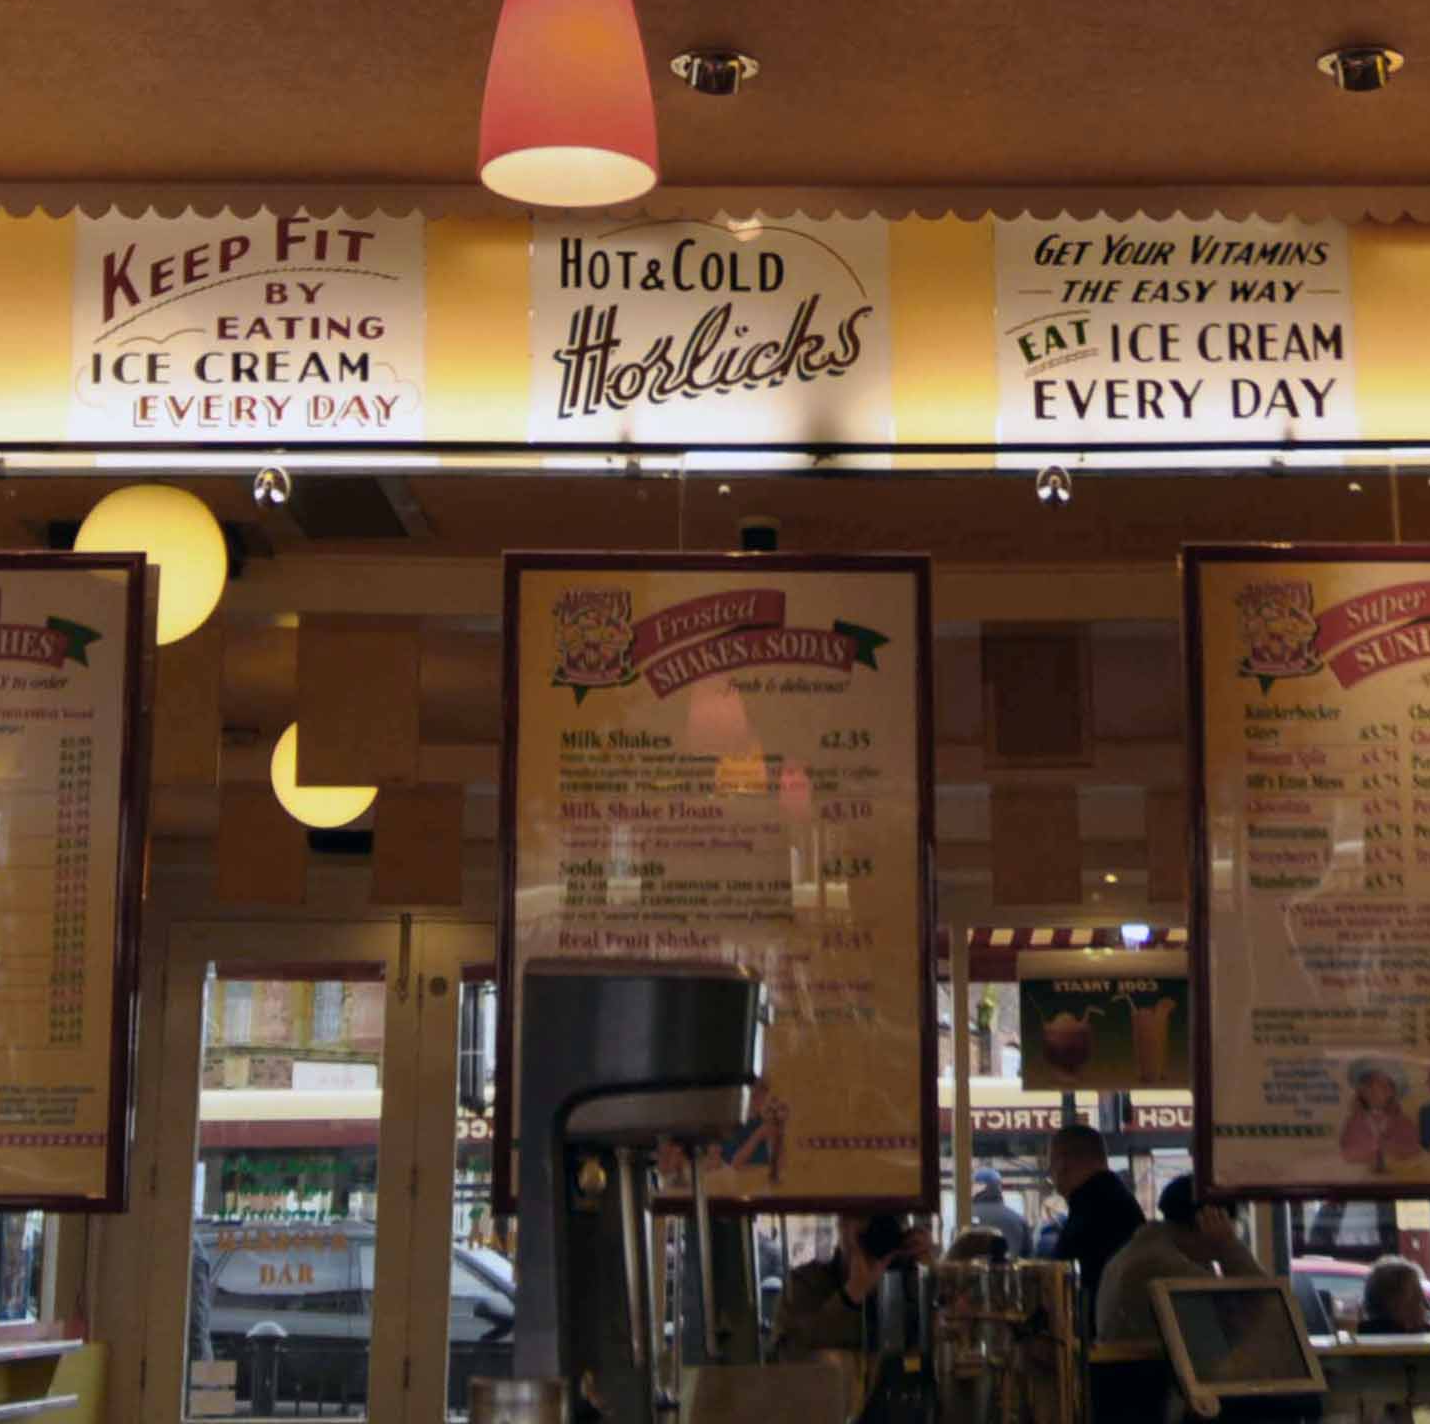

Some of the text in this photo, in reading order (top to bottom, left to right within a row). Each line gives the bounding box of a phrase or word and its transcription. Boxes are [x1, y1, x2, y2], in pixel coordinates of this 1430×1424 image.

[1034, 232, 1331, 269] GET YOUR VITAMINS
[101, 216, 377, 325] KEEP FIT
[265, 281, 326, 306] BY
[1059, 278, 1305, 306] THE EASY WAY
[214, 314, 386, 342] EATING
[1015, 314, 1347, 366] EAT ICE CREAM
[91, 350, 374, 385] ICE CREAM
[553, 292, 875, 421] Horlicks
[133, 393, 402, 429] EVERY DAY
[1032, 377, 1339, 423] EVERY DAY
[654, 594, 758, 644] Frosted
[1346, 587, 1428, 630] Super
[654, 636, 749, 691] SHAKES
[763, 630, 847, 662] SODAS
[560, 730, 603, 749] Milk
[607, 729, 673, 749] Shakes
[559, 801, 603, 820] Milk
[607, 801, 663, 820] Shake
[668, 801, 724, 820] Floats
[559, 859, 604, 878] Soda
[559, 929, 721, 949] Real Fruit Shakes
